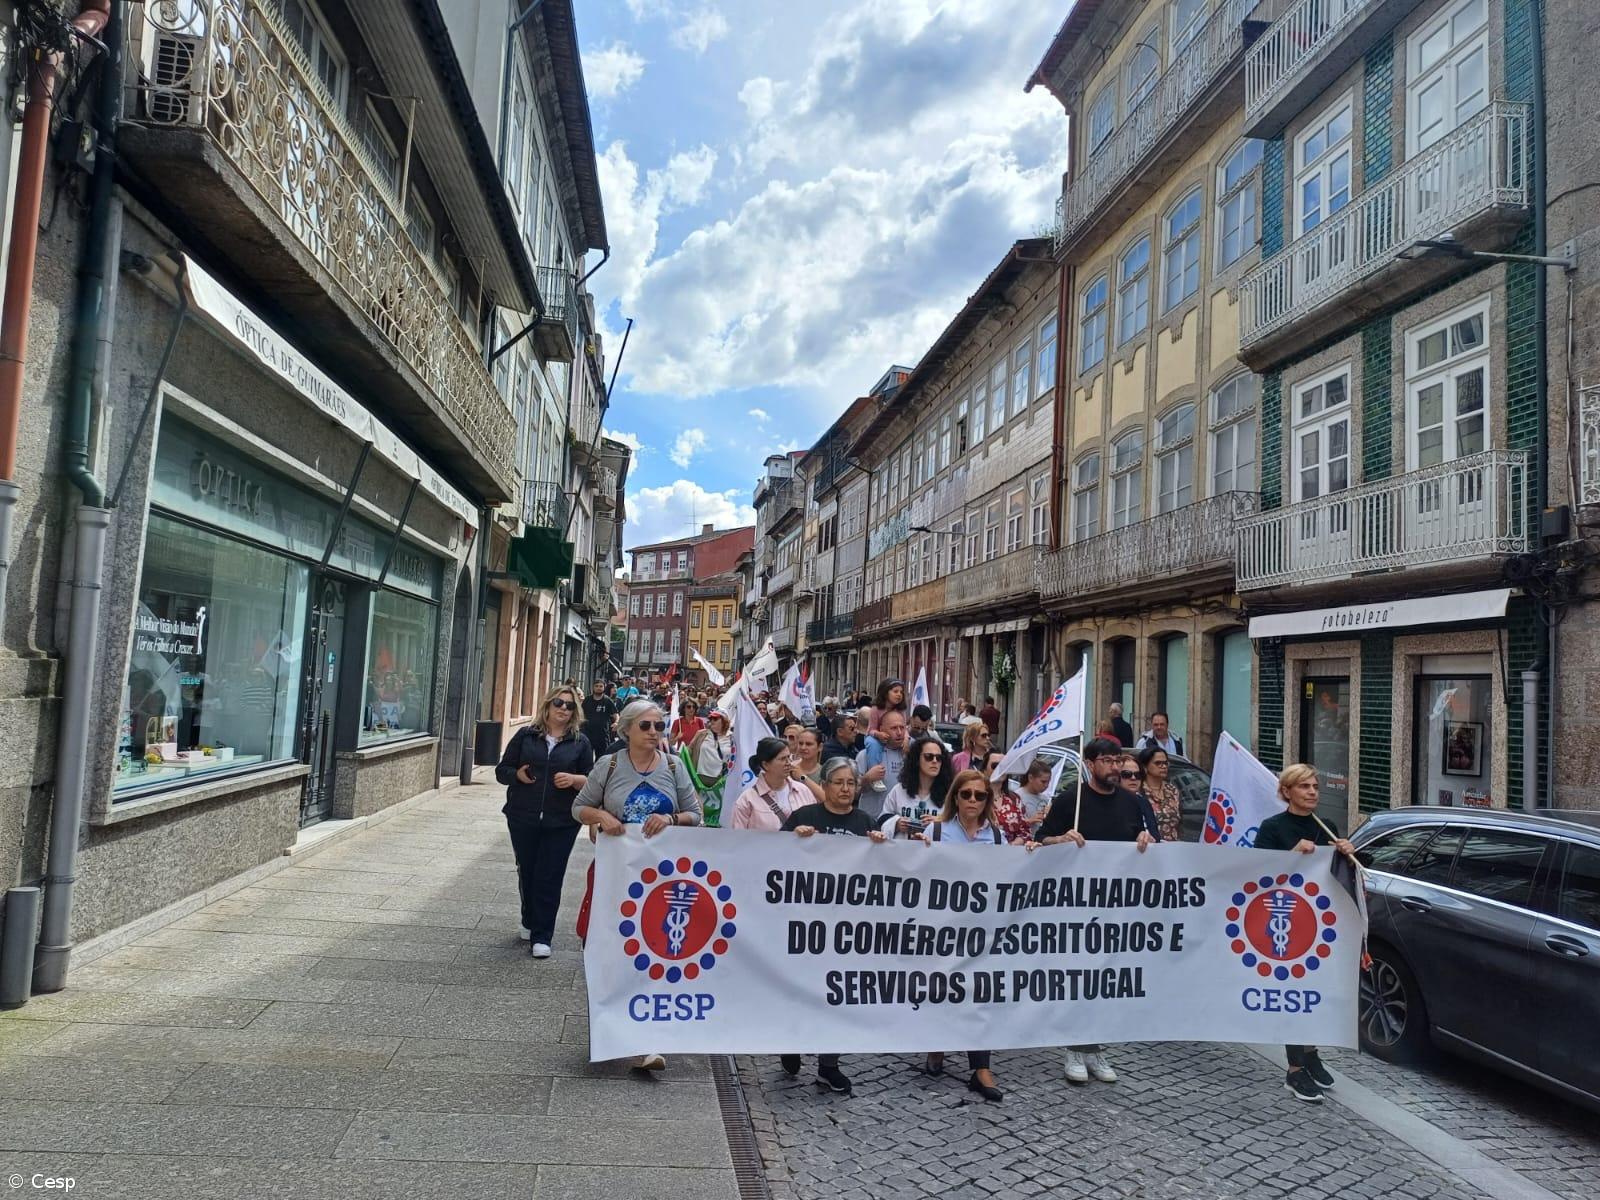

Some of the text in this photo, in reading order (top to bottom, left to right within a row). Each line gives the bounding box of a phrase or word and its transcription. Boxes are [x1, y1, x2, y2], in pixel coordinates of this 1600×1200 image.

[235, 310, 347, 420] ÓPTICA DE GUIMARÃES
[1321, 608, 1389, 631] fotobeleza
[901, 806, 911, 818] GO
[766, 870, 1205, 913] SINDICATO DOS TRABALHADORES
[788, 917, 1183, 957] DO COMÉRCIO ESCRITÓRIOS E
[827, 967, 1145, 1010] SERVIÇOS DE PORTUGAL
[1242, 988, 1321, 1013] CESP
[629, 994, 714, 1021] CESP
